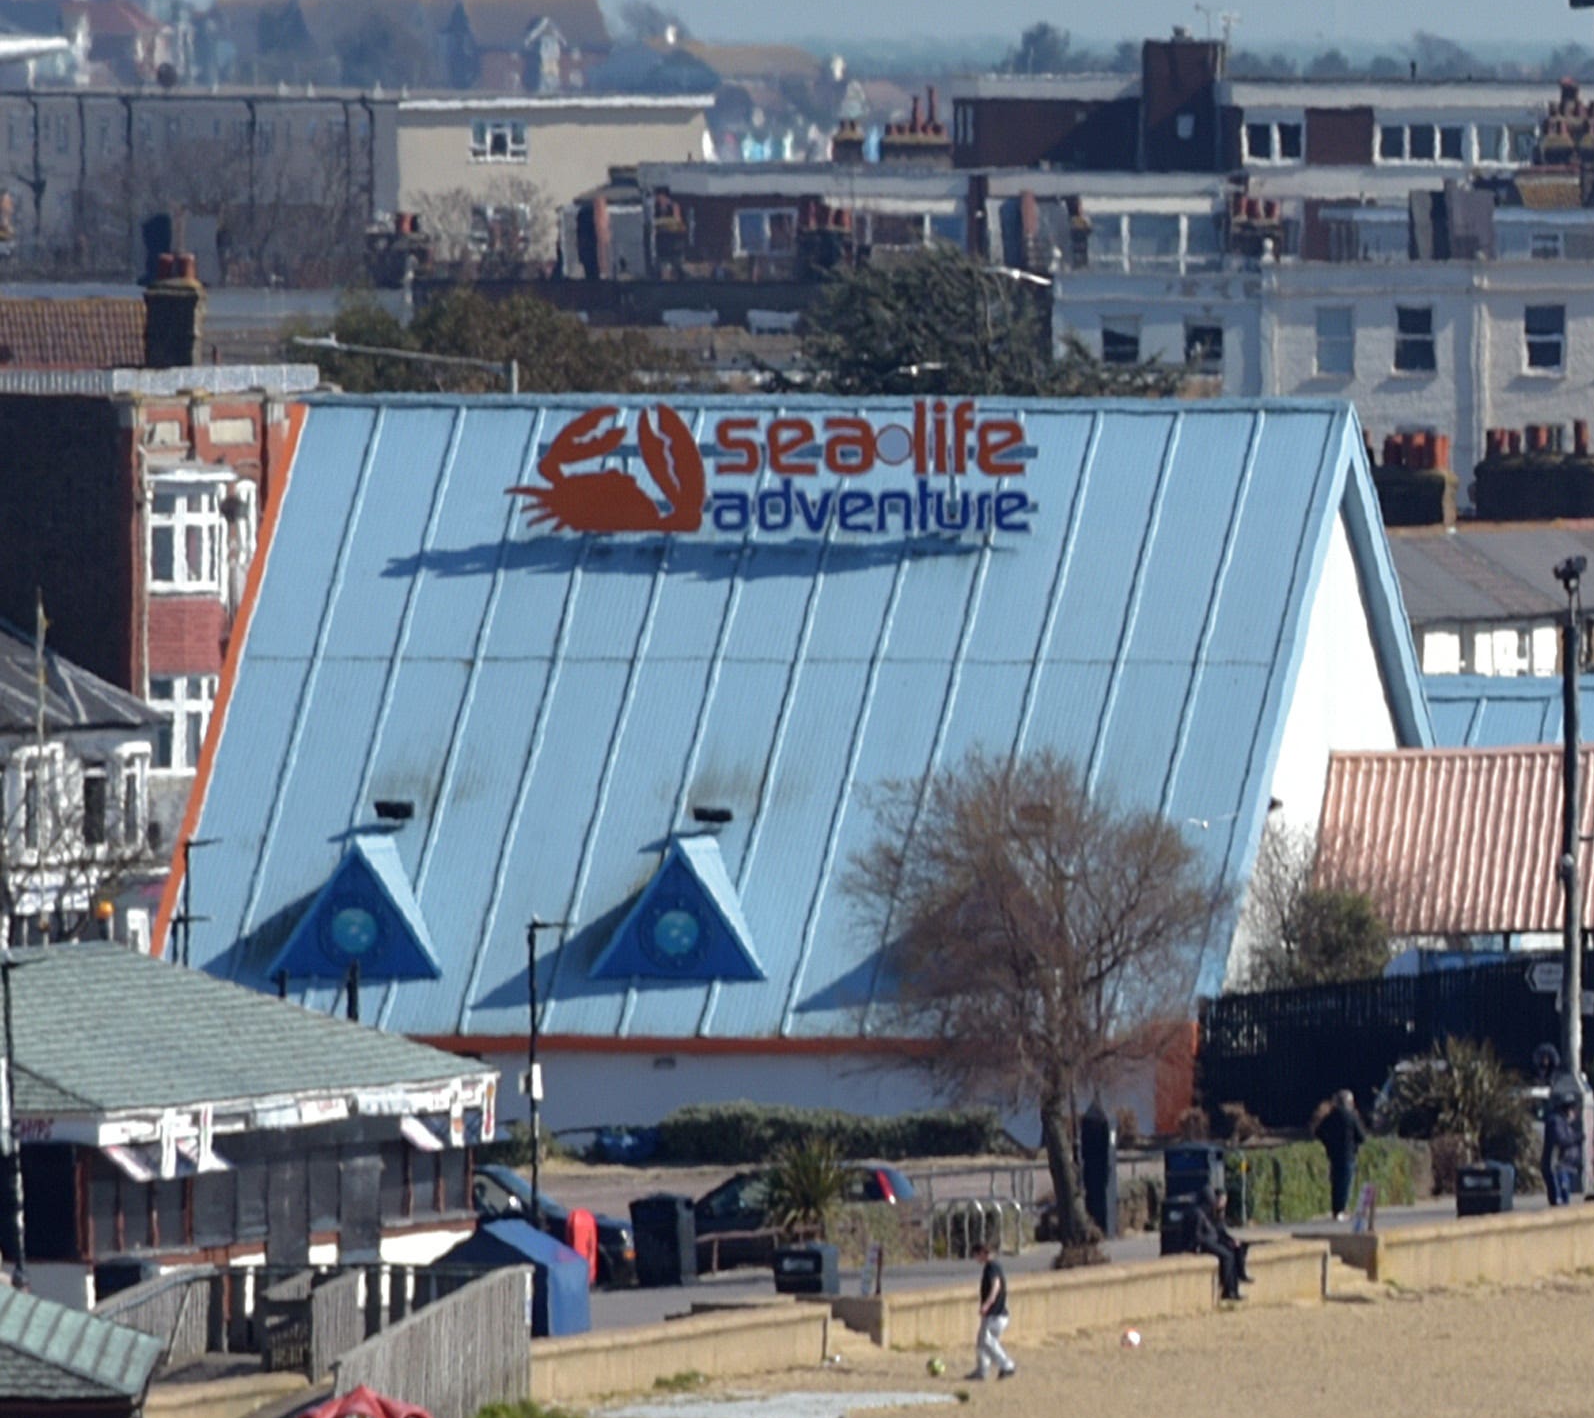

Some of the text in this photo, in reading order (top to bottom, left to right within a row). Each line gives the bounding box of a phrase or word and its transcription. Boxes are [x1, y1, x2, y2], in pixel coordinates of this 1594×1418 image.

[715, 399, 1026, 475] sea life
[712, 478, 1031, 533] adventure
